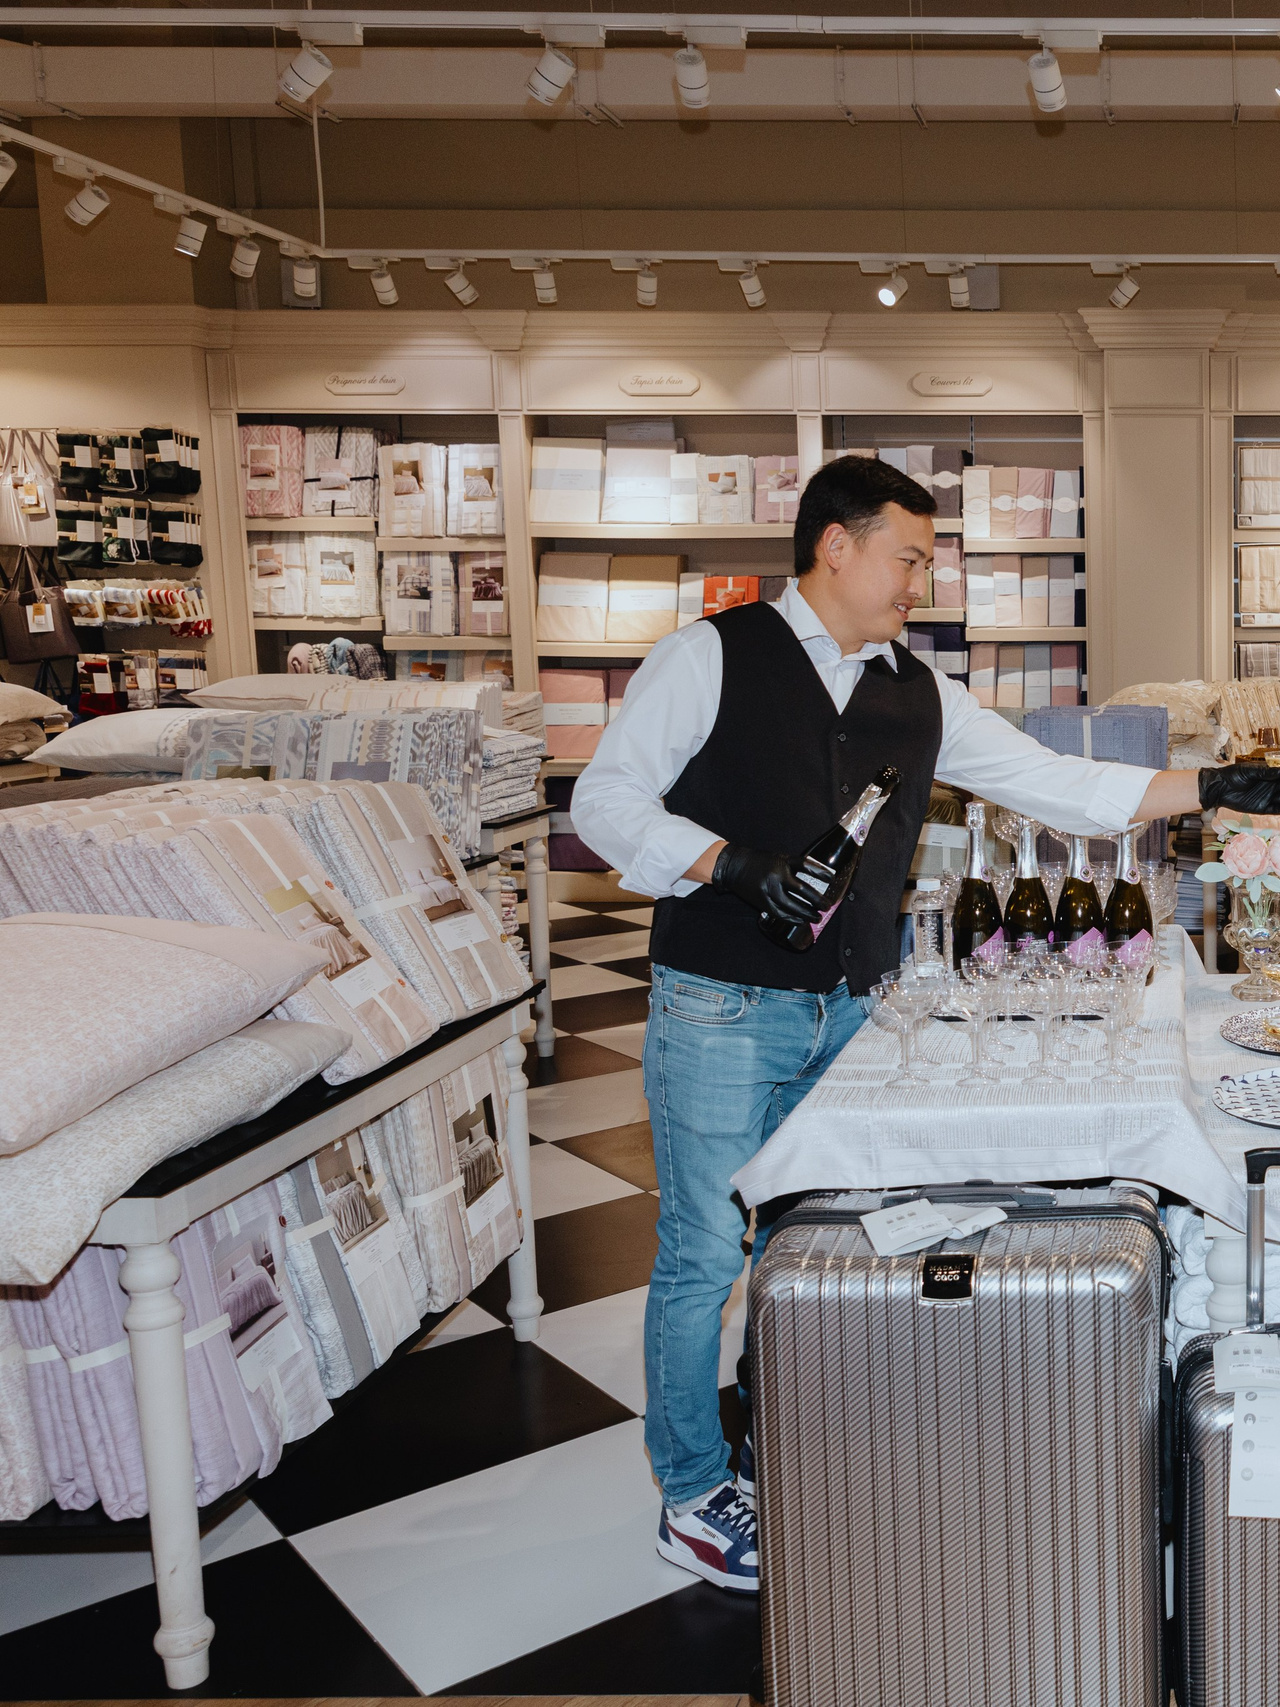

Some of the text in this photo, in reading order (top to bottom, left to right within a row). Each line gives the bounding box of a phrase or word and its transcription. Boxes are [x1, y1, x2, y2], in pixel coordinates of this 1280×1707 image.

[368, 375, 377, 384] de
[379, 375, 397, 384] bain
[655, 376, 664, 385] de
[666, 376, 683, 385] bain
[929, 1264, 967, 1272] MADAM
[934, 1274, 960, 1282] COCO
